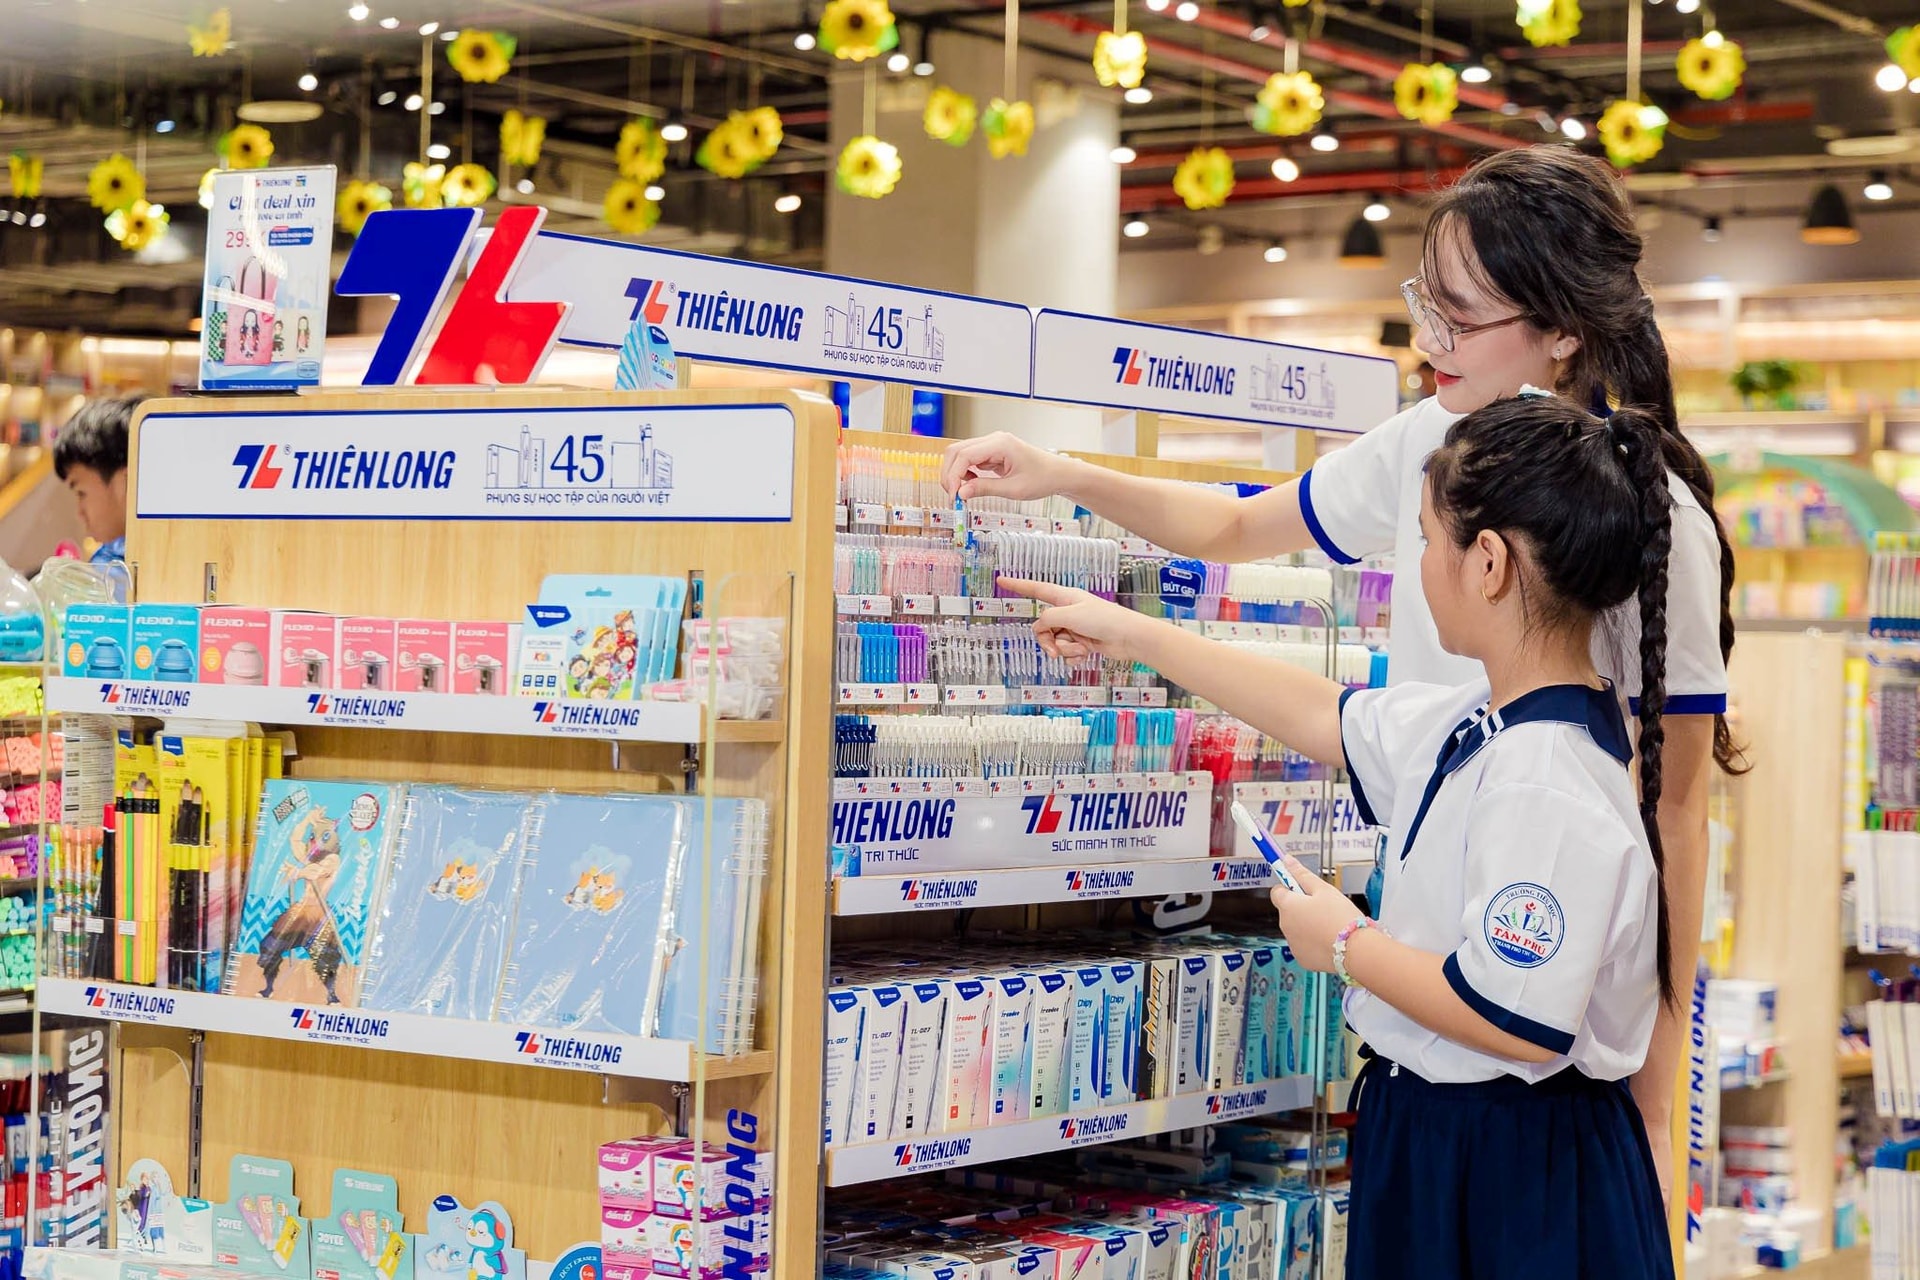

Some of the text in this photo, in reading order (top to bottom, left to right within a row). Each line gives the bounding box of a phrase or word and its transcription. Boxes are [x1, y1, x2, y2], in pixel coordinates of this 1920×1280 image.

[868, 306, 903, 349] 45
[1281, 364, 1306, 400] 45
[550, 434, 605, 483] 45
[486, 489, 672, 508] PHỤNG SỰ HỌC TẬP CỦA NGƯỜI VIỆT
[1162, 580, 1181, 593] BÚT
[1052, 834, 1157, 852] SỨC MẠNH TRI THỨC
[865, 847, 920, 863] TRI THỨC
